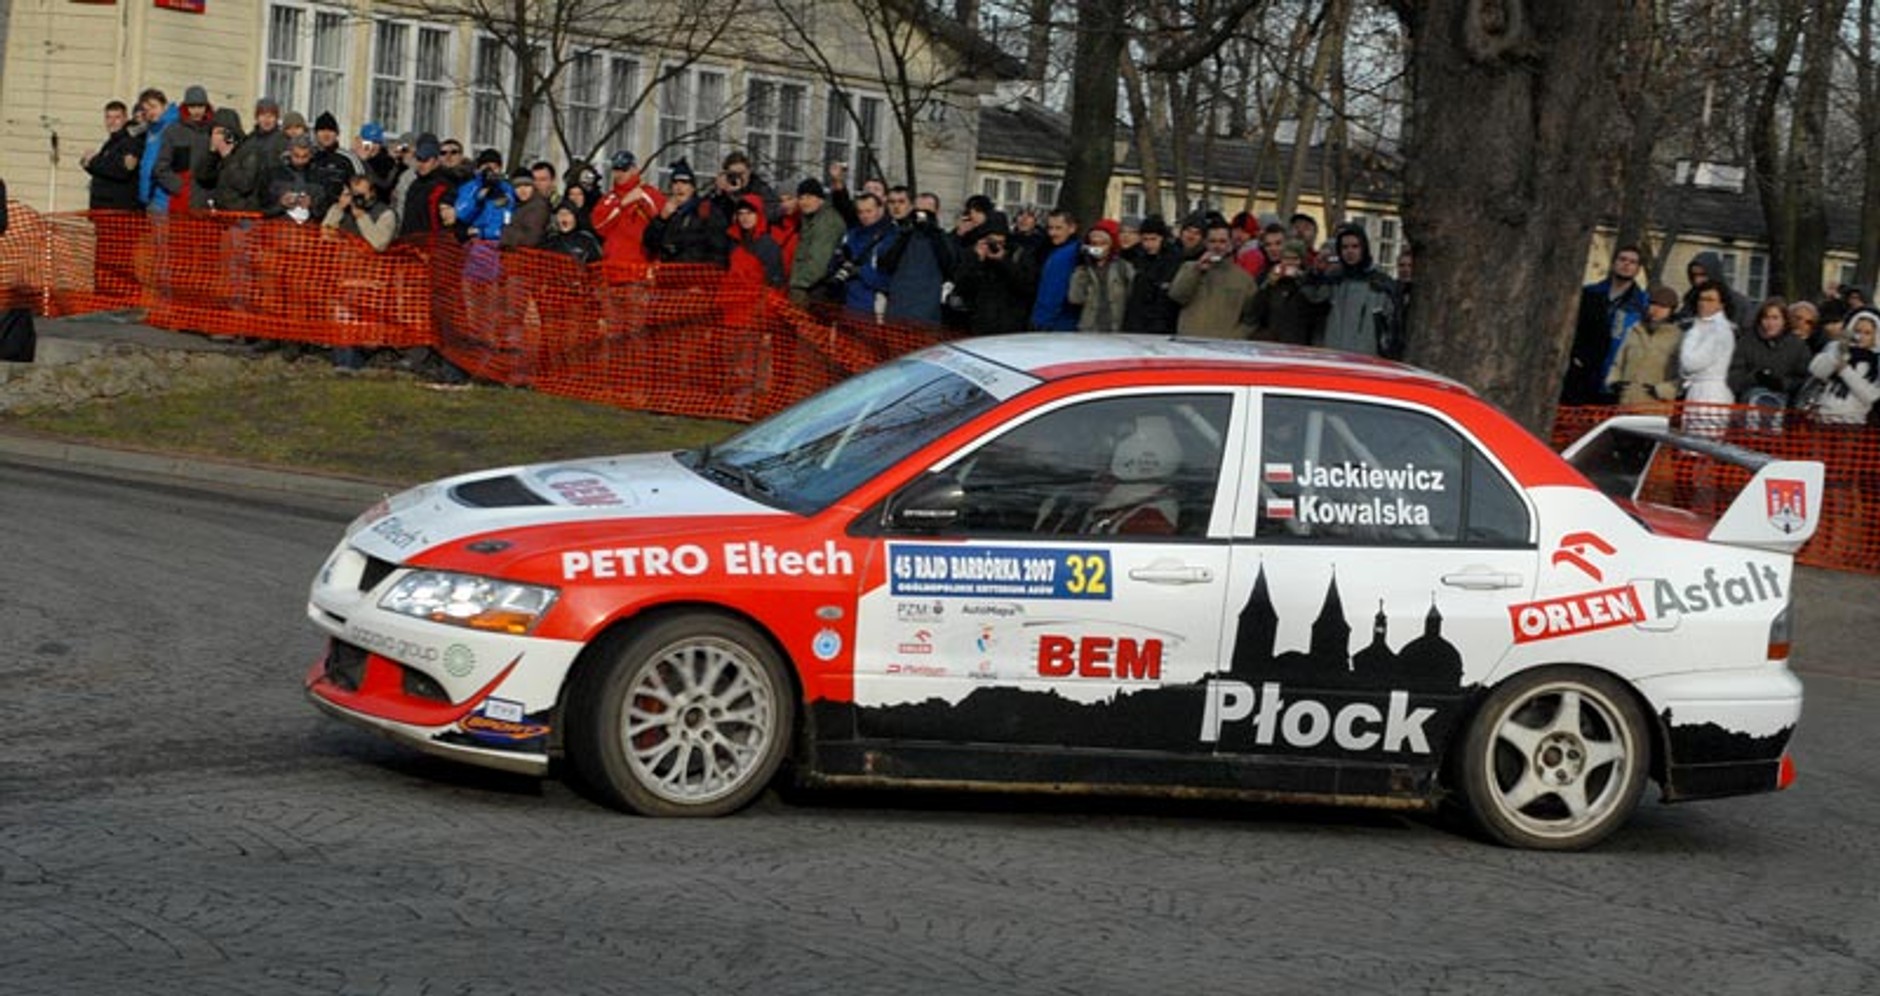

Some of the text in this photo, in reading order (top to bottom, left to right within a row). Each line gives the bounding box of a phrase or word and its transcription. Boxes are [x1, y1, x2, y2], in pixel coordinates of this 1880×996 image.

[1297, 460, 1445, 491] Jackiewicz
[1298, 495, 1430, 526] Kowalska
[561, 540, 854, 579] PETRO Eltech
[894, 550, 1056, 582] 45 RAJD BARBÓRKA 2007
[1065, 554, 1106, 594] 32
[897, 603, 928, 615] PZM
[962, 604, 1016, 616] AutoMapa
[1519, 562, 1783, 636] ORLEN Asfalt
[398, 638, 439, 662] group
[1037, 635, 1163, 679] BEM
[1199, 679, 1437, 754] Płock
